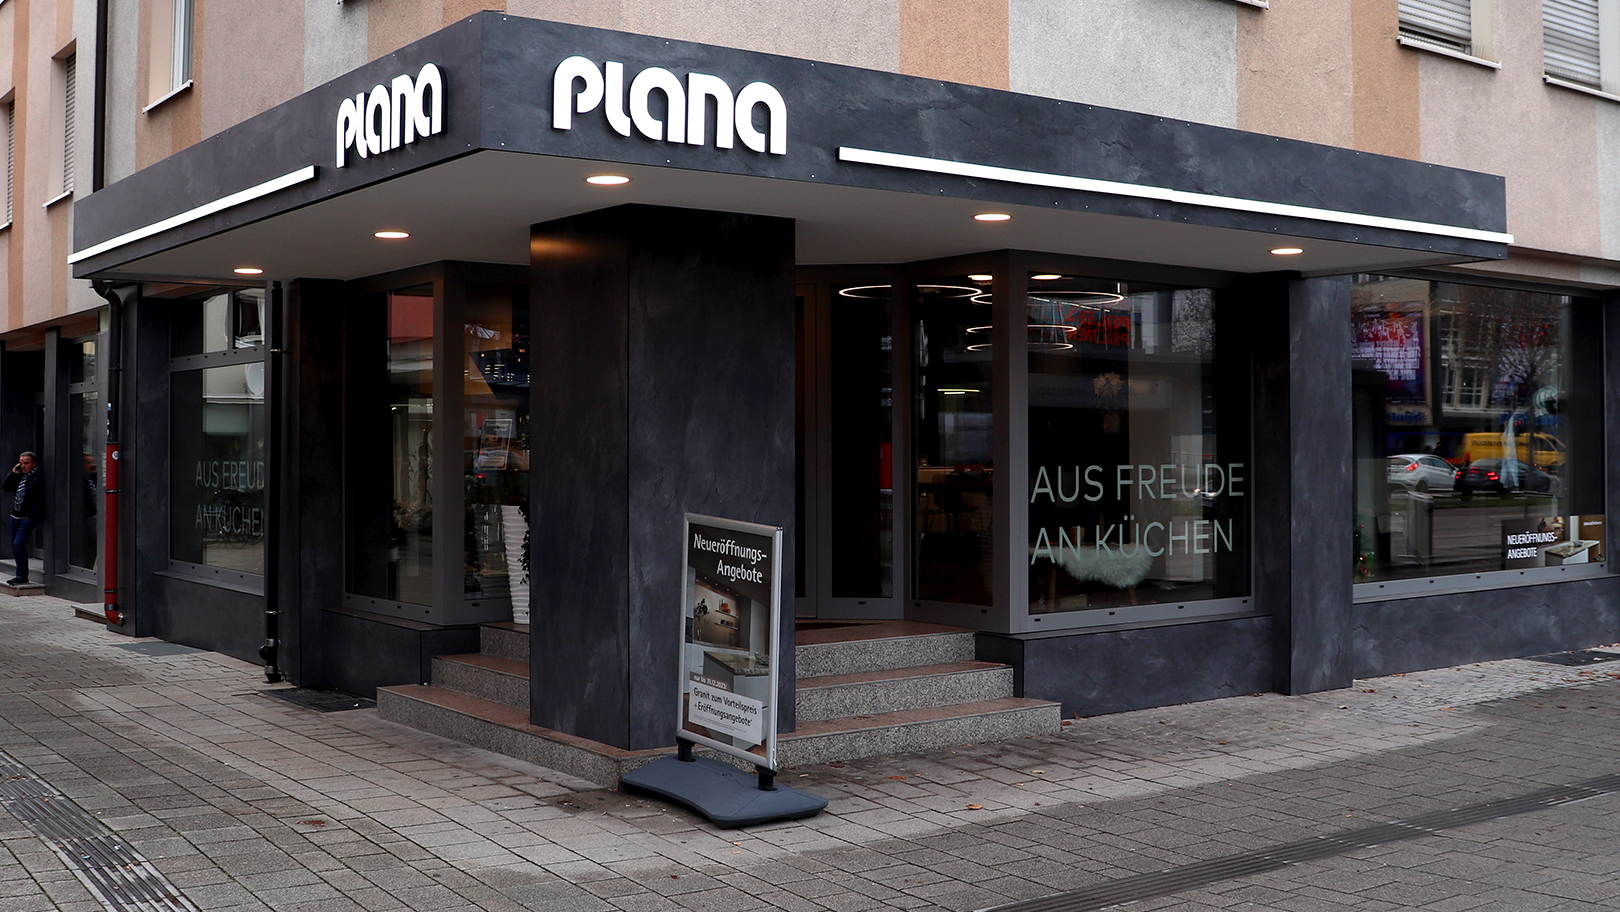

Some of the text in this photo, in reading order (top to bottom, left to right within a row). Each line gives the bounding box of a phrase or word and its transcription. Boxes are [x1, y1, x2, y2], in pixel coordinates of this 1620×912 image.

[195, 460, 265, 490] AUS FREUD
[1030, 463, 1244, 503] AUS FREUDE
[195, 503, 212, 531] AN
[693, 533, 767, 565] Neueröffnungs-
[1030, 515, 1233, 565] AN KÜCHEN
[1507, 531, 1558, 545] NEUERÖFFNUNGS-
[1507, 547, 1538, 560] ANGEBOTE
[716, 559, 763, 584] Angebote
[693, 687, 758, 715] Granit zum Vorteilspreis
